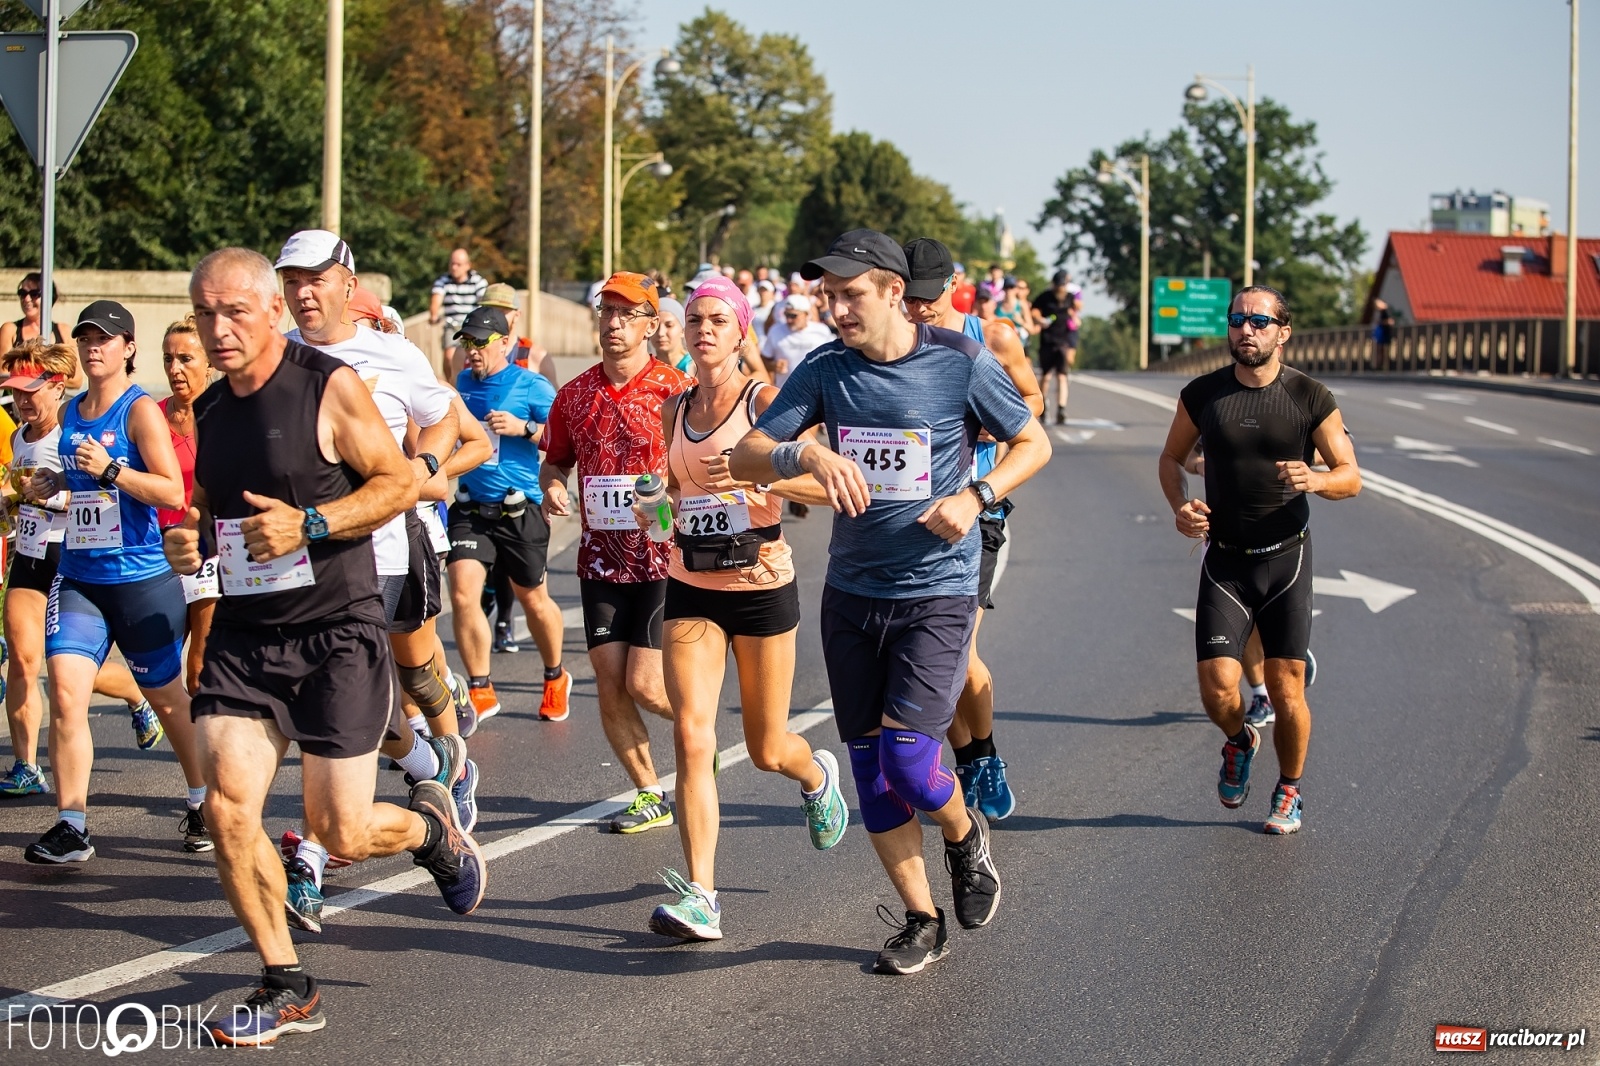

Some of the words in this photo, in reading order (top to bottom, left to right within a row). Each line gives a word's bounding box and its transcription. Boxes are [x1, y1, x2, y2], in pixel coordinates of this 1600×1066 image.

[863, 447, 907, 471] 455
[602, 490, 633, 508] 115
[75, 507, 101, 526] 101
[689, 511, 729, 535] 228
